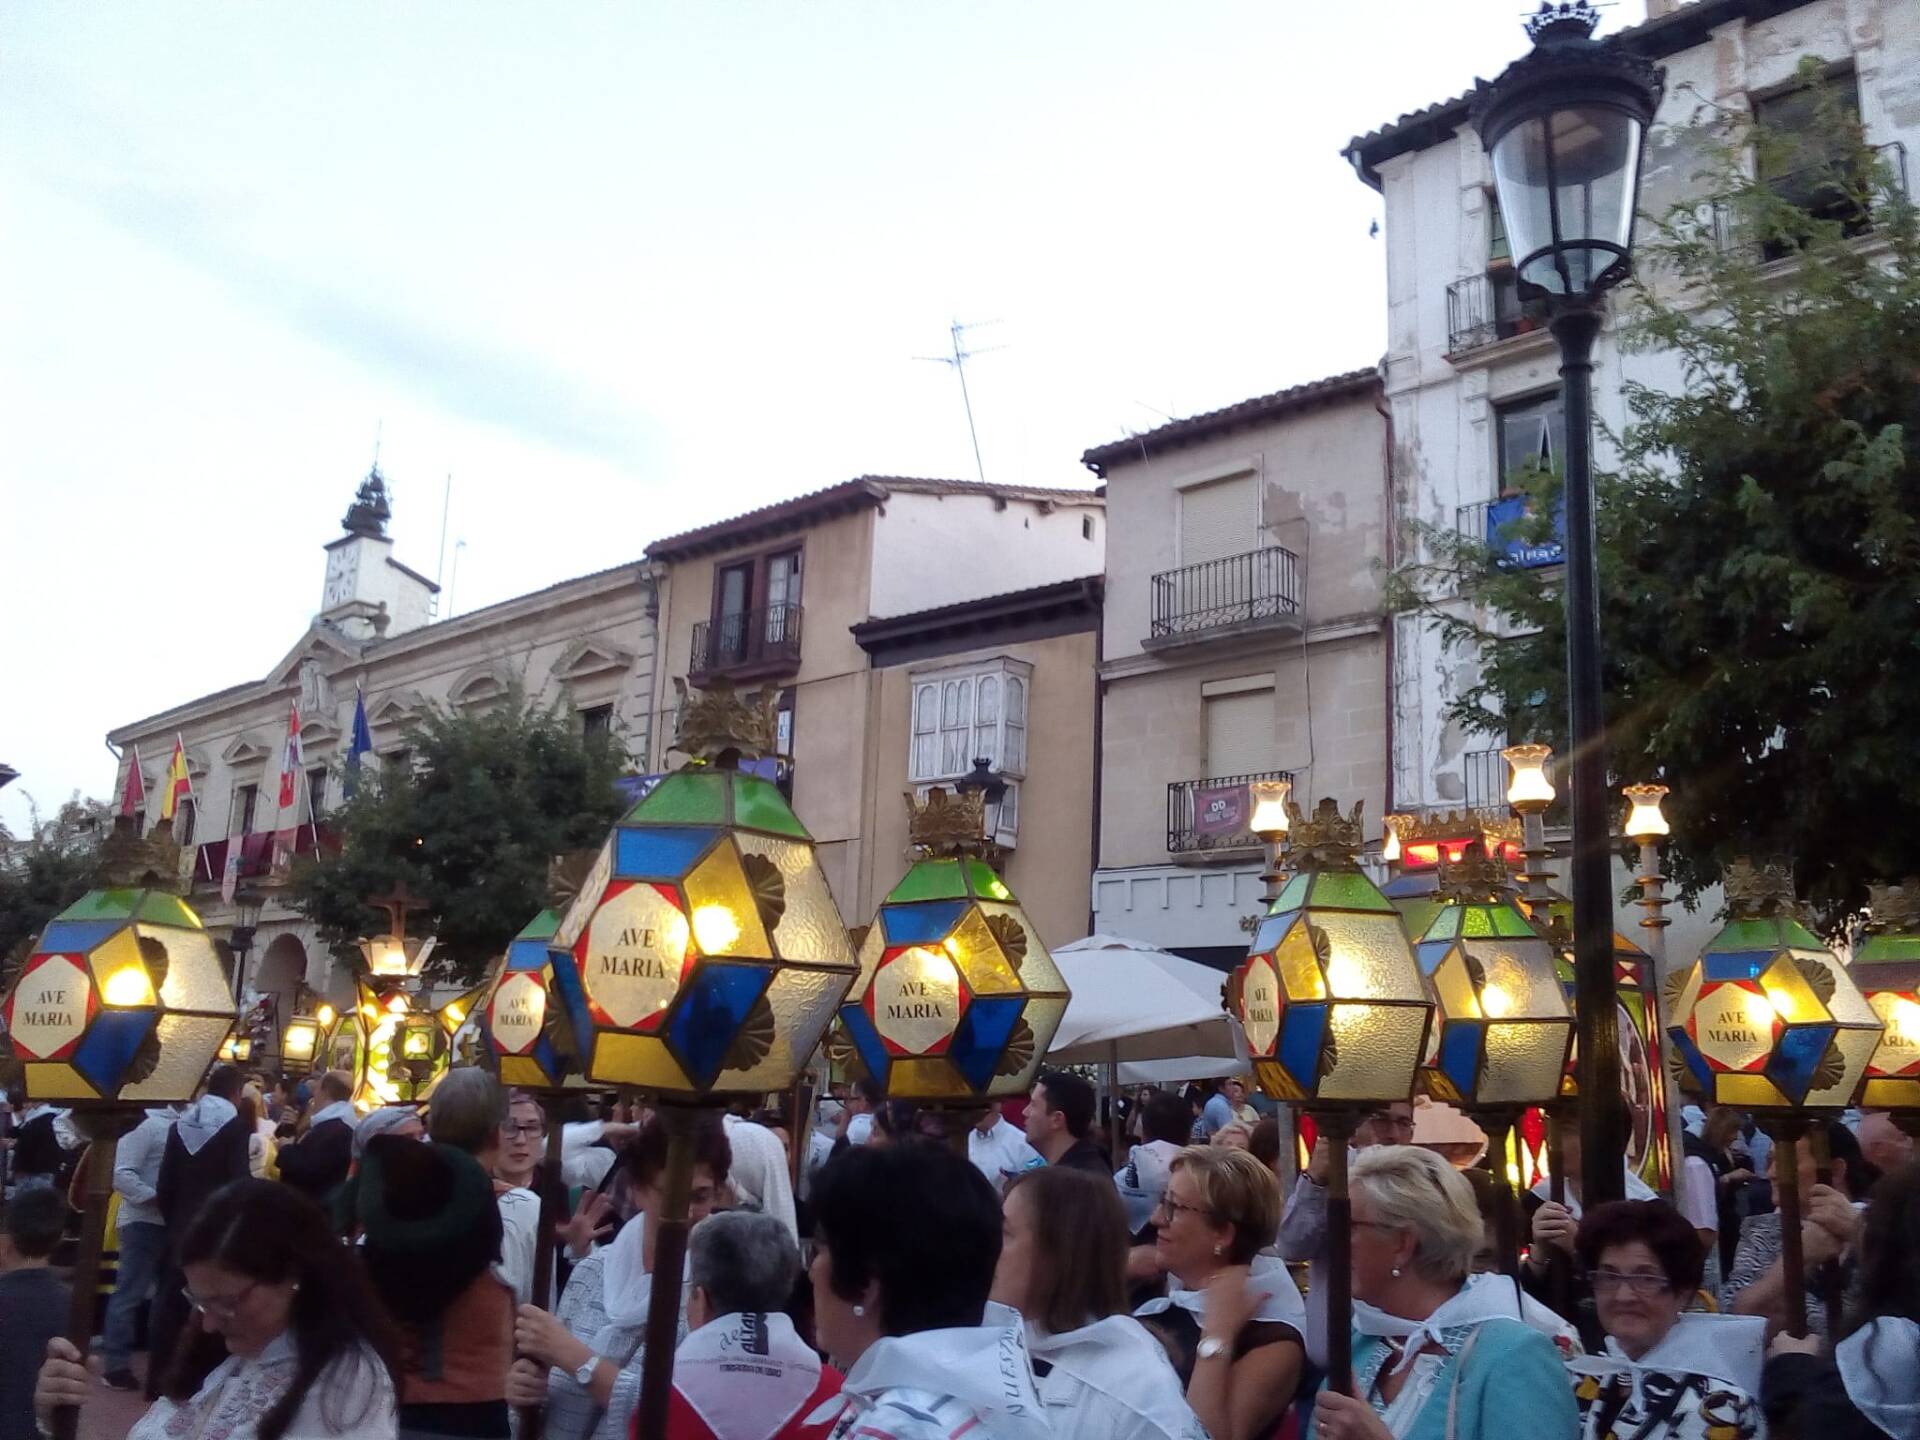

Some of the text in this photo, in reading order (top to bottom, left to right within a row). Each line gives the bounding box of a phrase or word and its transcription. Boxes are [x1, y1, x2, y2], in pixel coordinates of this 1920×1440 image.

[616, 928, 656, 948] AVE
[600, 955, 665, 979] MARIA
[899, 982, 930, 997] AVE
[36, 990, 66, 1005] AVE
[22, 1012, 73, 1026] MARIA
[887, 1004, 943, 1019] MARIA
[1718, 1011, 1745, 1024] AVE
[500, 1015, 532, 1026] MARIA
[1708, 1030, 1758, 1042] MARIA
